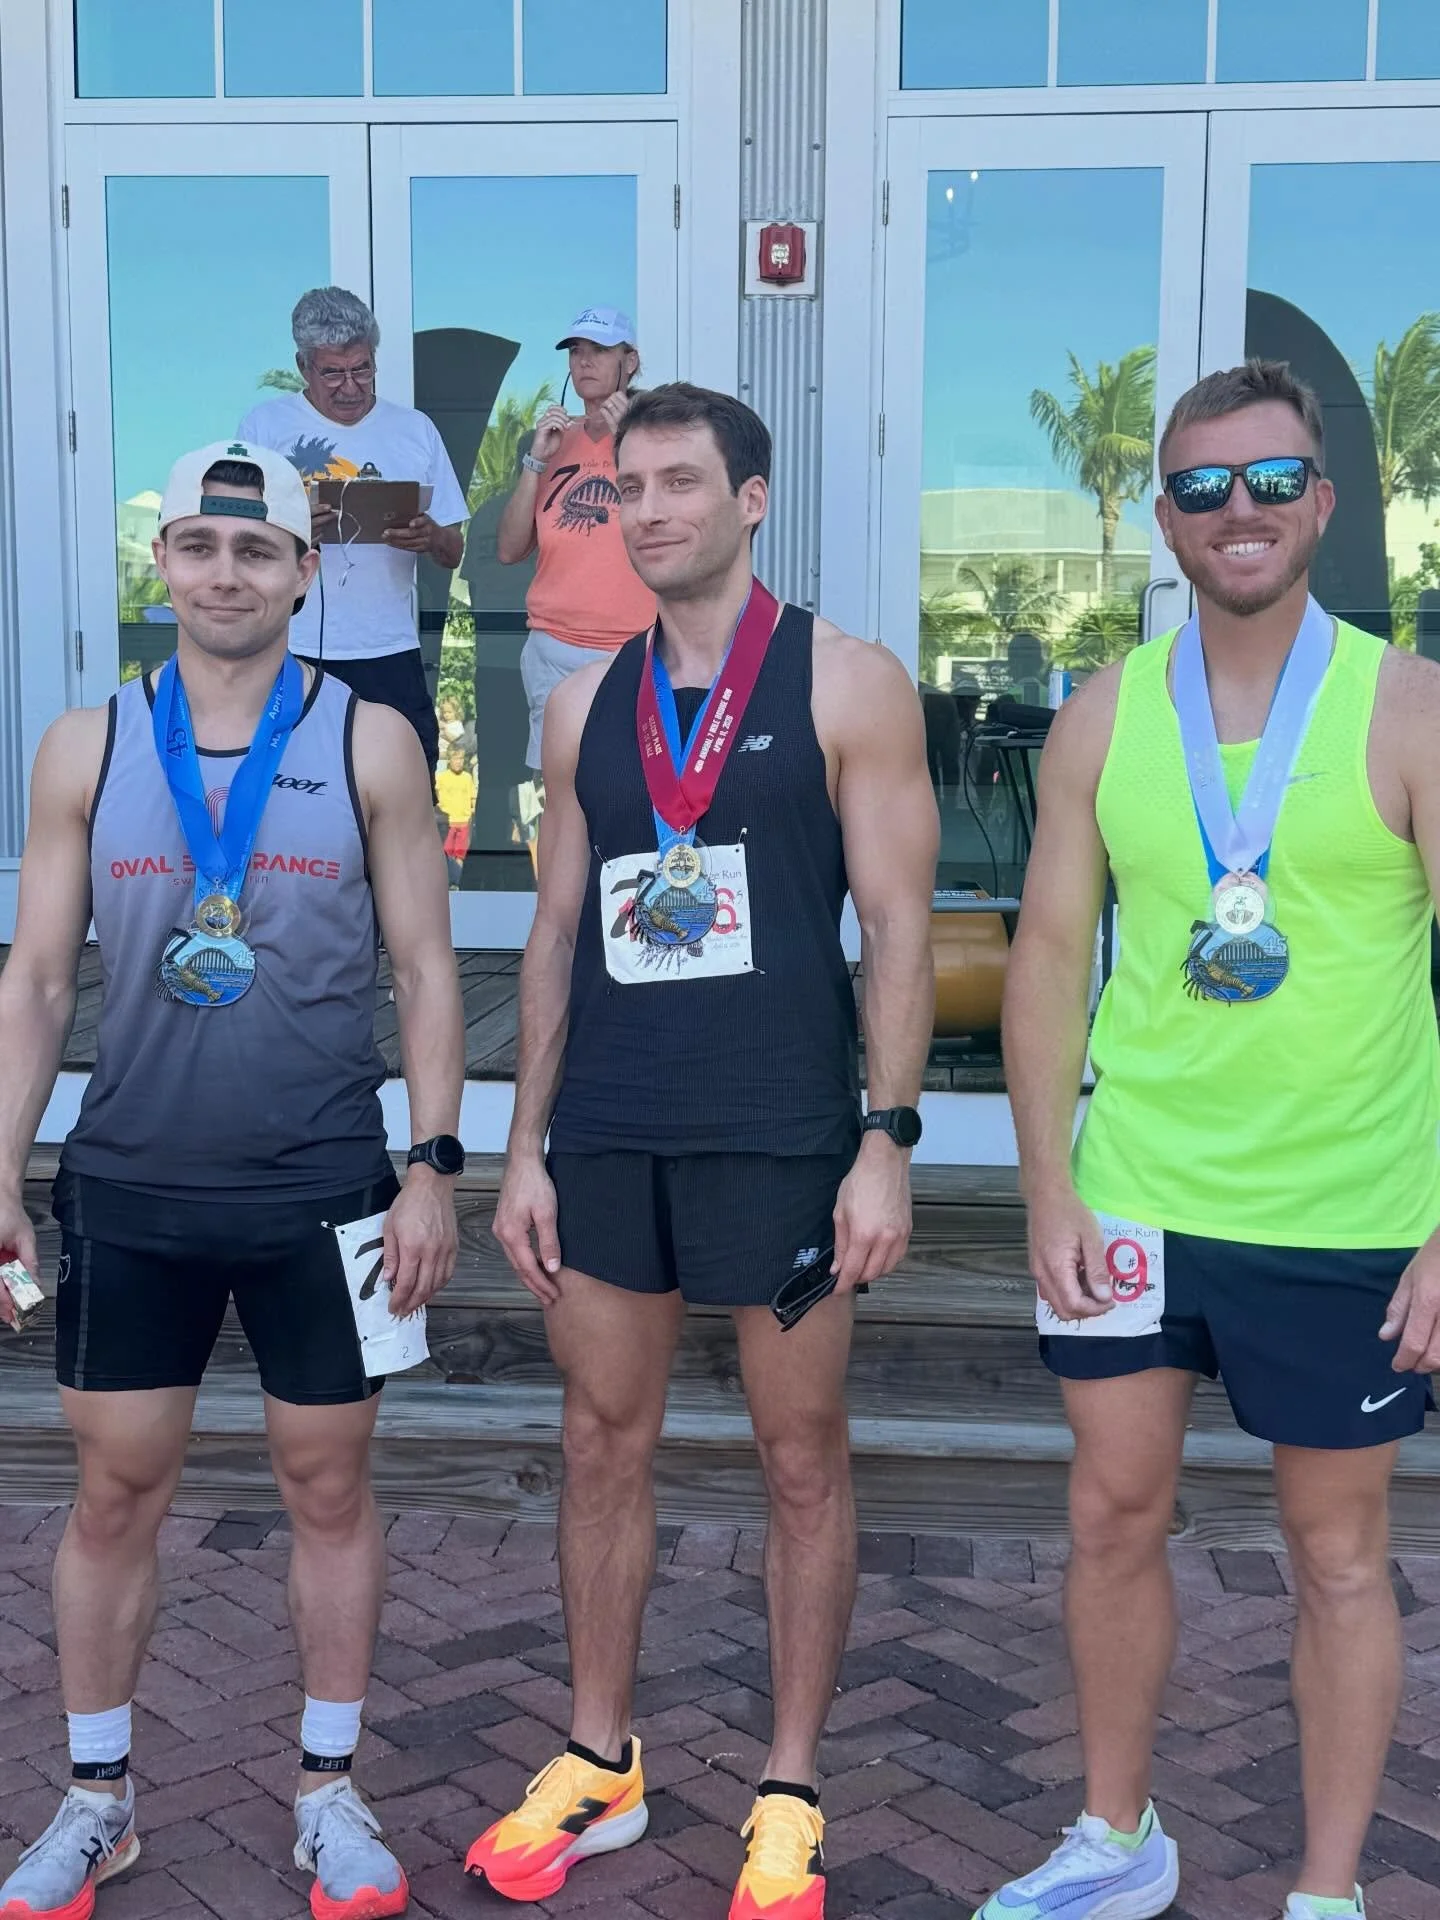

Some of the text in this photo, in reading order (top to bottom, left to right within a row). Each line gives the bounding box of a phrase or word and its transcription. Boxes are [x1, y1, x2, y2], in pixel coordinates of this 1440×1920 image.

[543, 463, 580, 512] 7
[111, 855, 174, 879] OVAL
[1135, 1227, 1159, 1239] Run
[97, 1763, 122, 1778] RIGHT
[318, 1758, 345, 1769] LEFT
